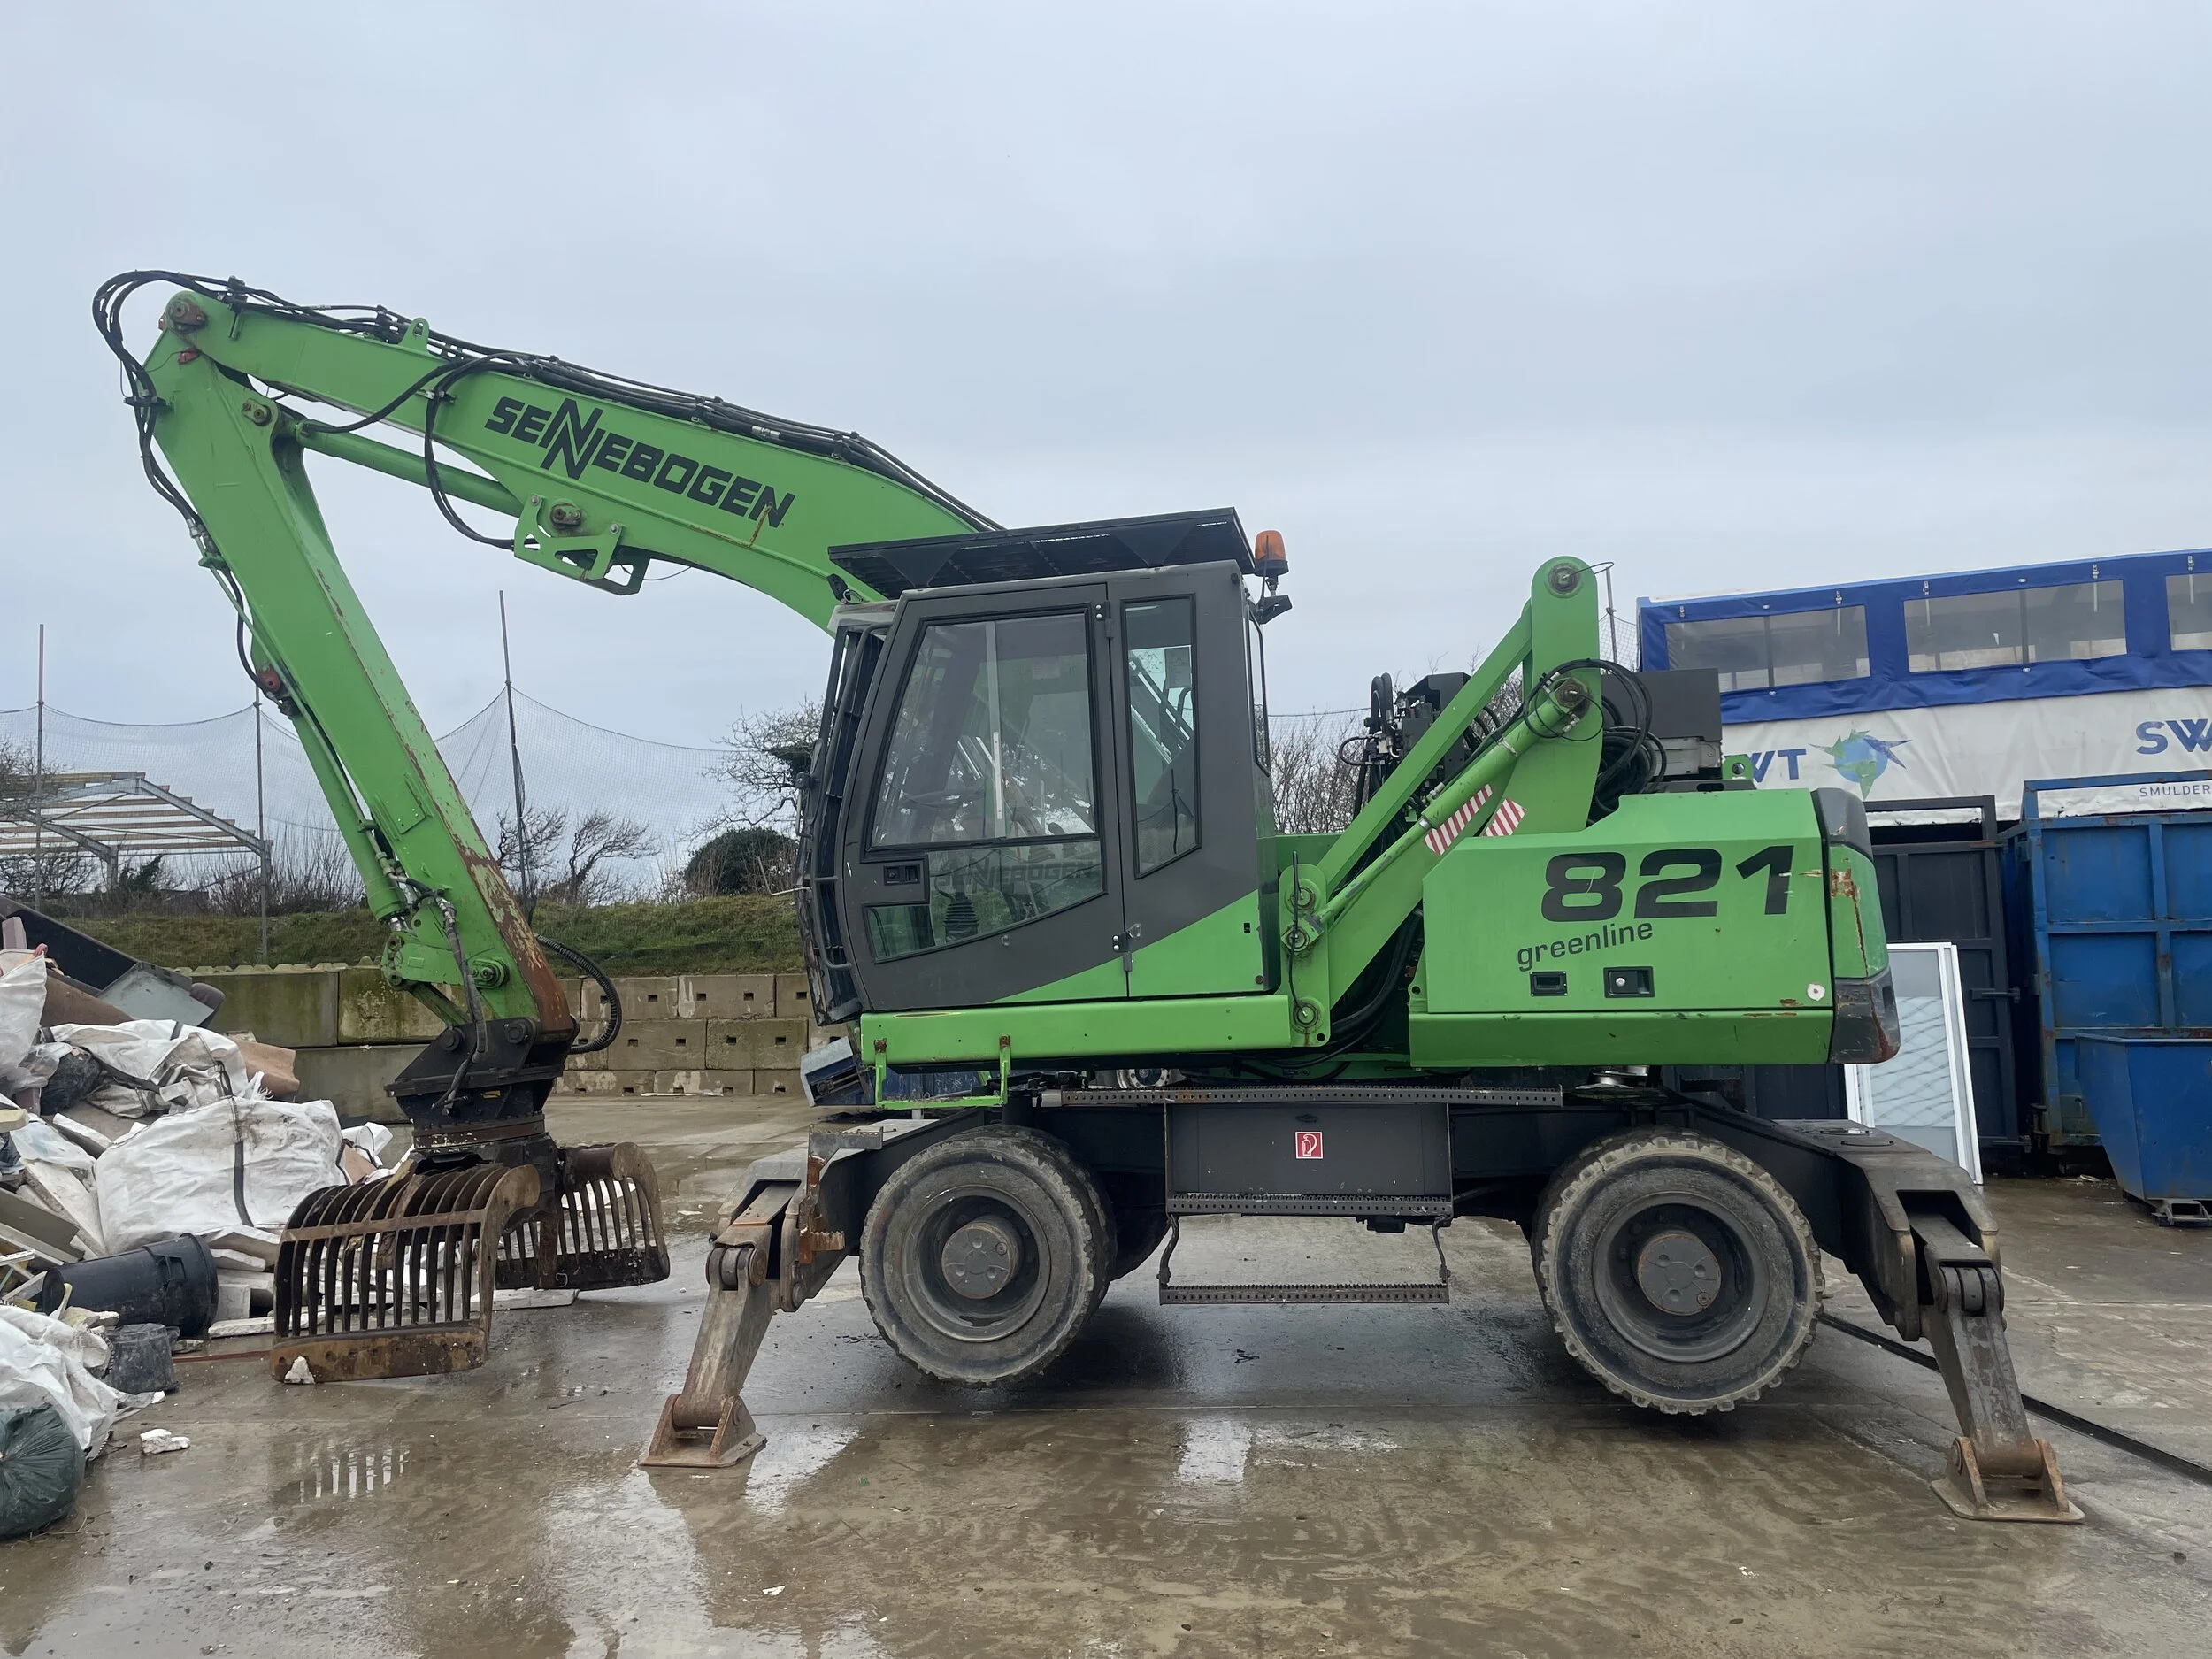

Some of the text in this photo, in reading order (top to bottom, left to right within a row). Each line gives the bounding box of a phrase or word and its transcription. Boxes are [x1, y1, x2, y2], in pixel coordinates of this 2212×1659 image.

[484, 396, 796, 528] SENNEBOGEN
[1541, 845, 1794, 922] 821
[1517, 922, 1653, 972] greenline
